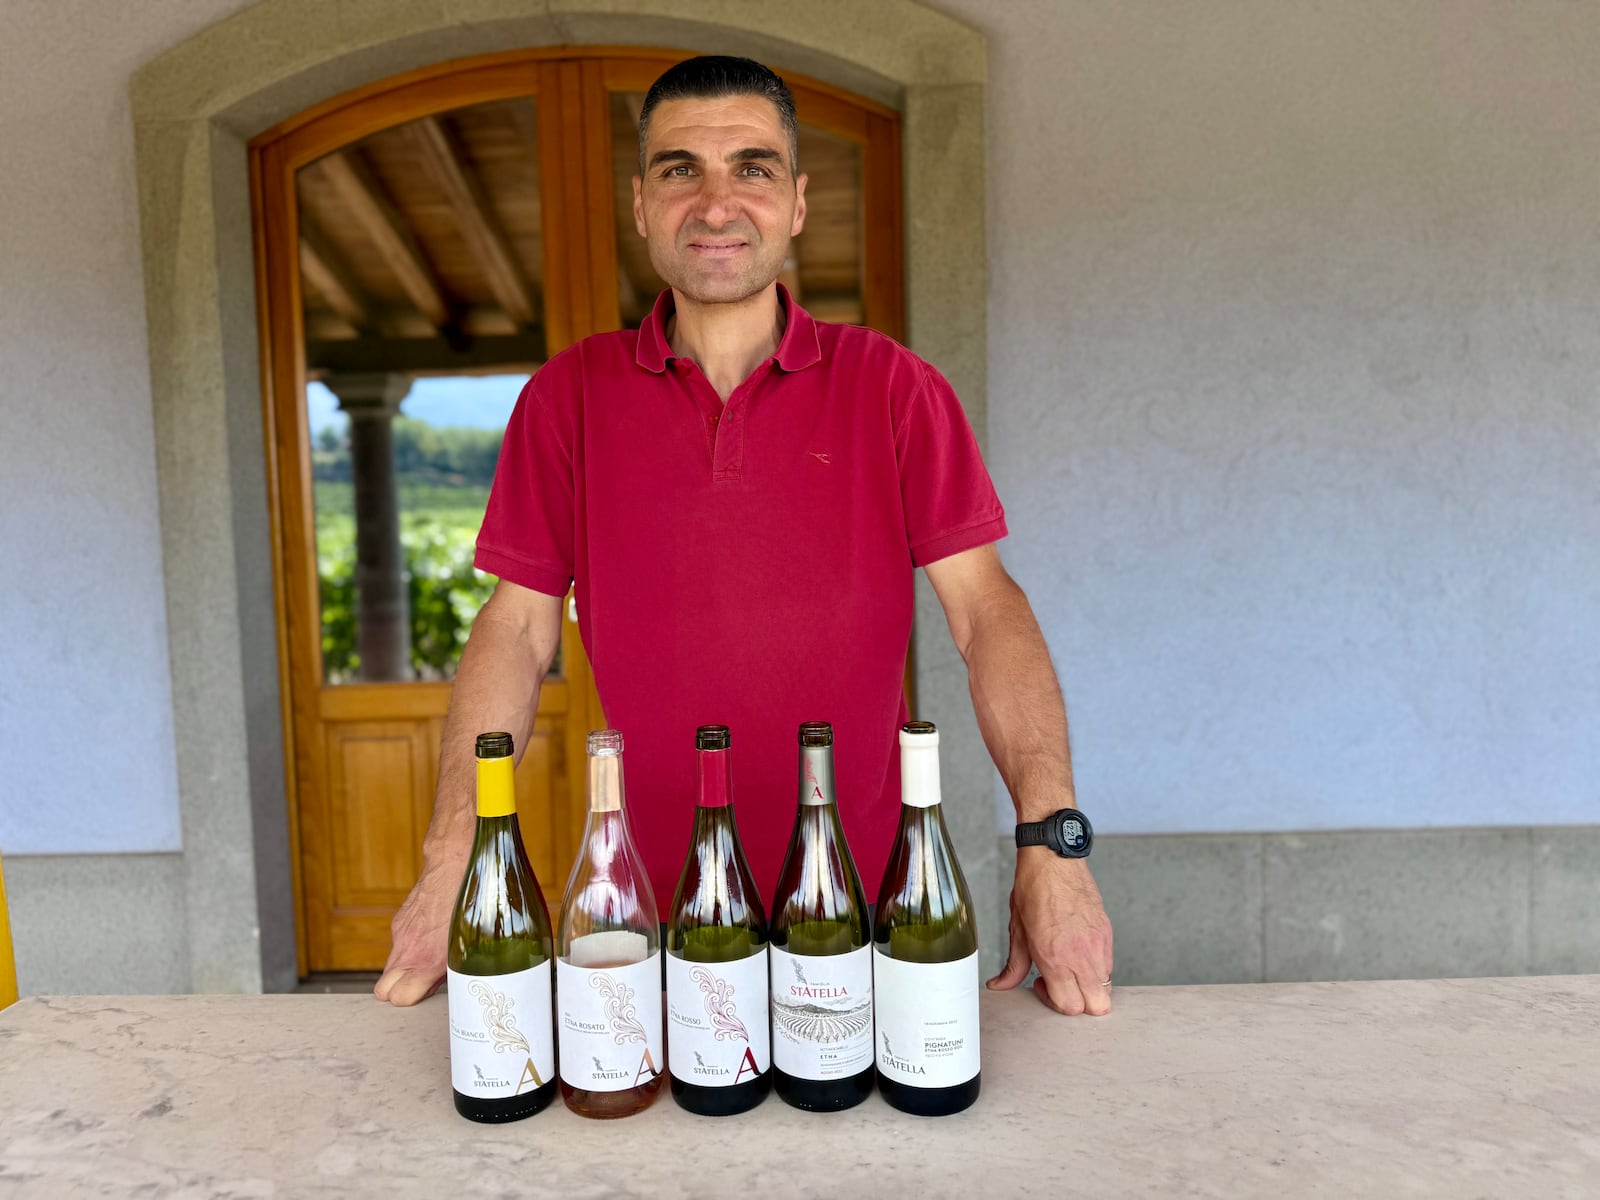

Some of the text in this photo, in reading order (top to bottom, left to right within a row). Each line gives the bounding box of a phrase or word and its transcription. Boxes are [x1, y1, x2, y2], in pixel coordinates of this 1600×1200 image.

[791, 985, 848, 998] STATELLA
[681, 1015, 701, 1025] ROSSO
[579, 1022, 605, 1031] ROSATO
[461, 1028, 485, 1039] BIANCO
[924, 1038, 964, 1049] PIGNATUNI
[881, 1053, 926, 1075] STATELLA
[592, 1071, 629, 1080] STATELLA
[693, 1067, 730, 1076] STATELLA
[473, 1080, 511, 1088] STATELLA
